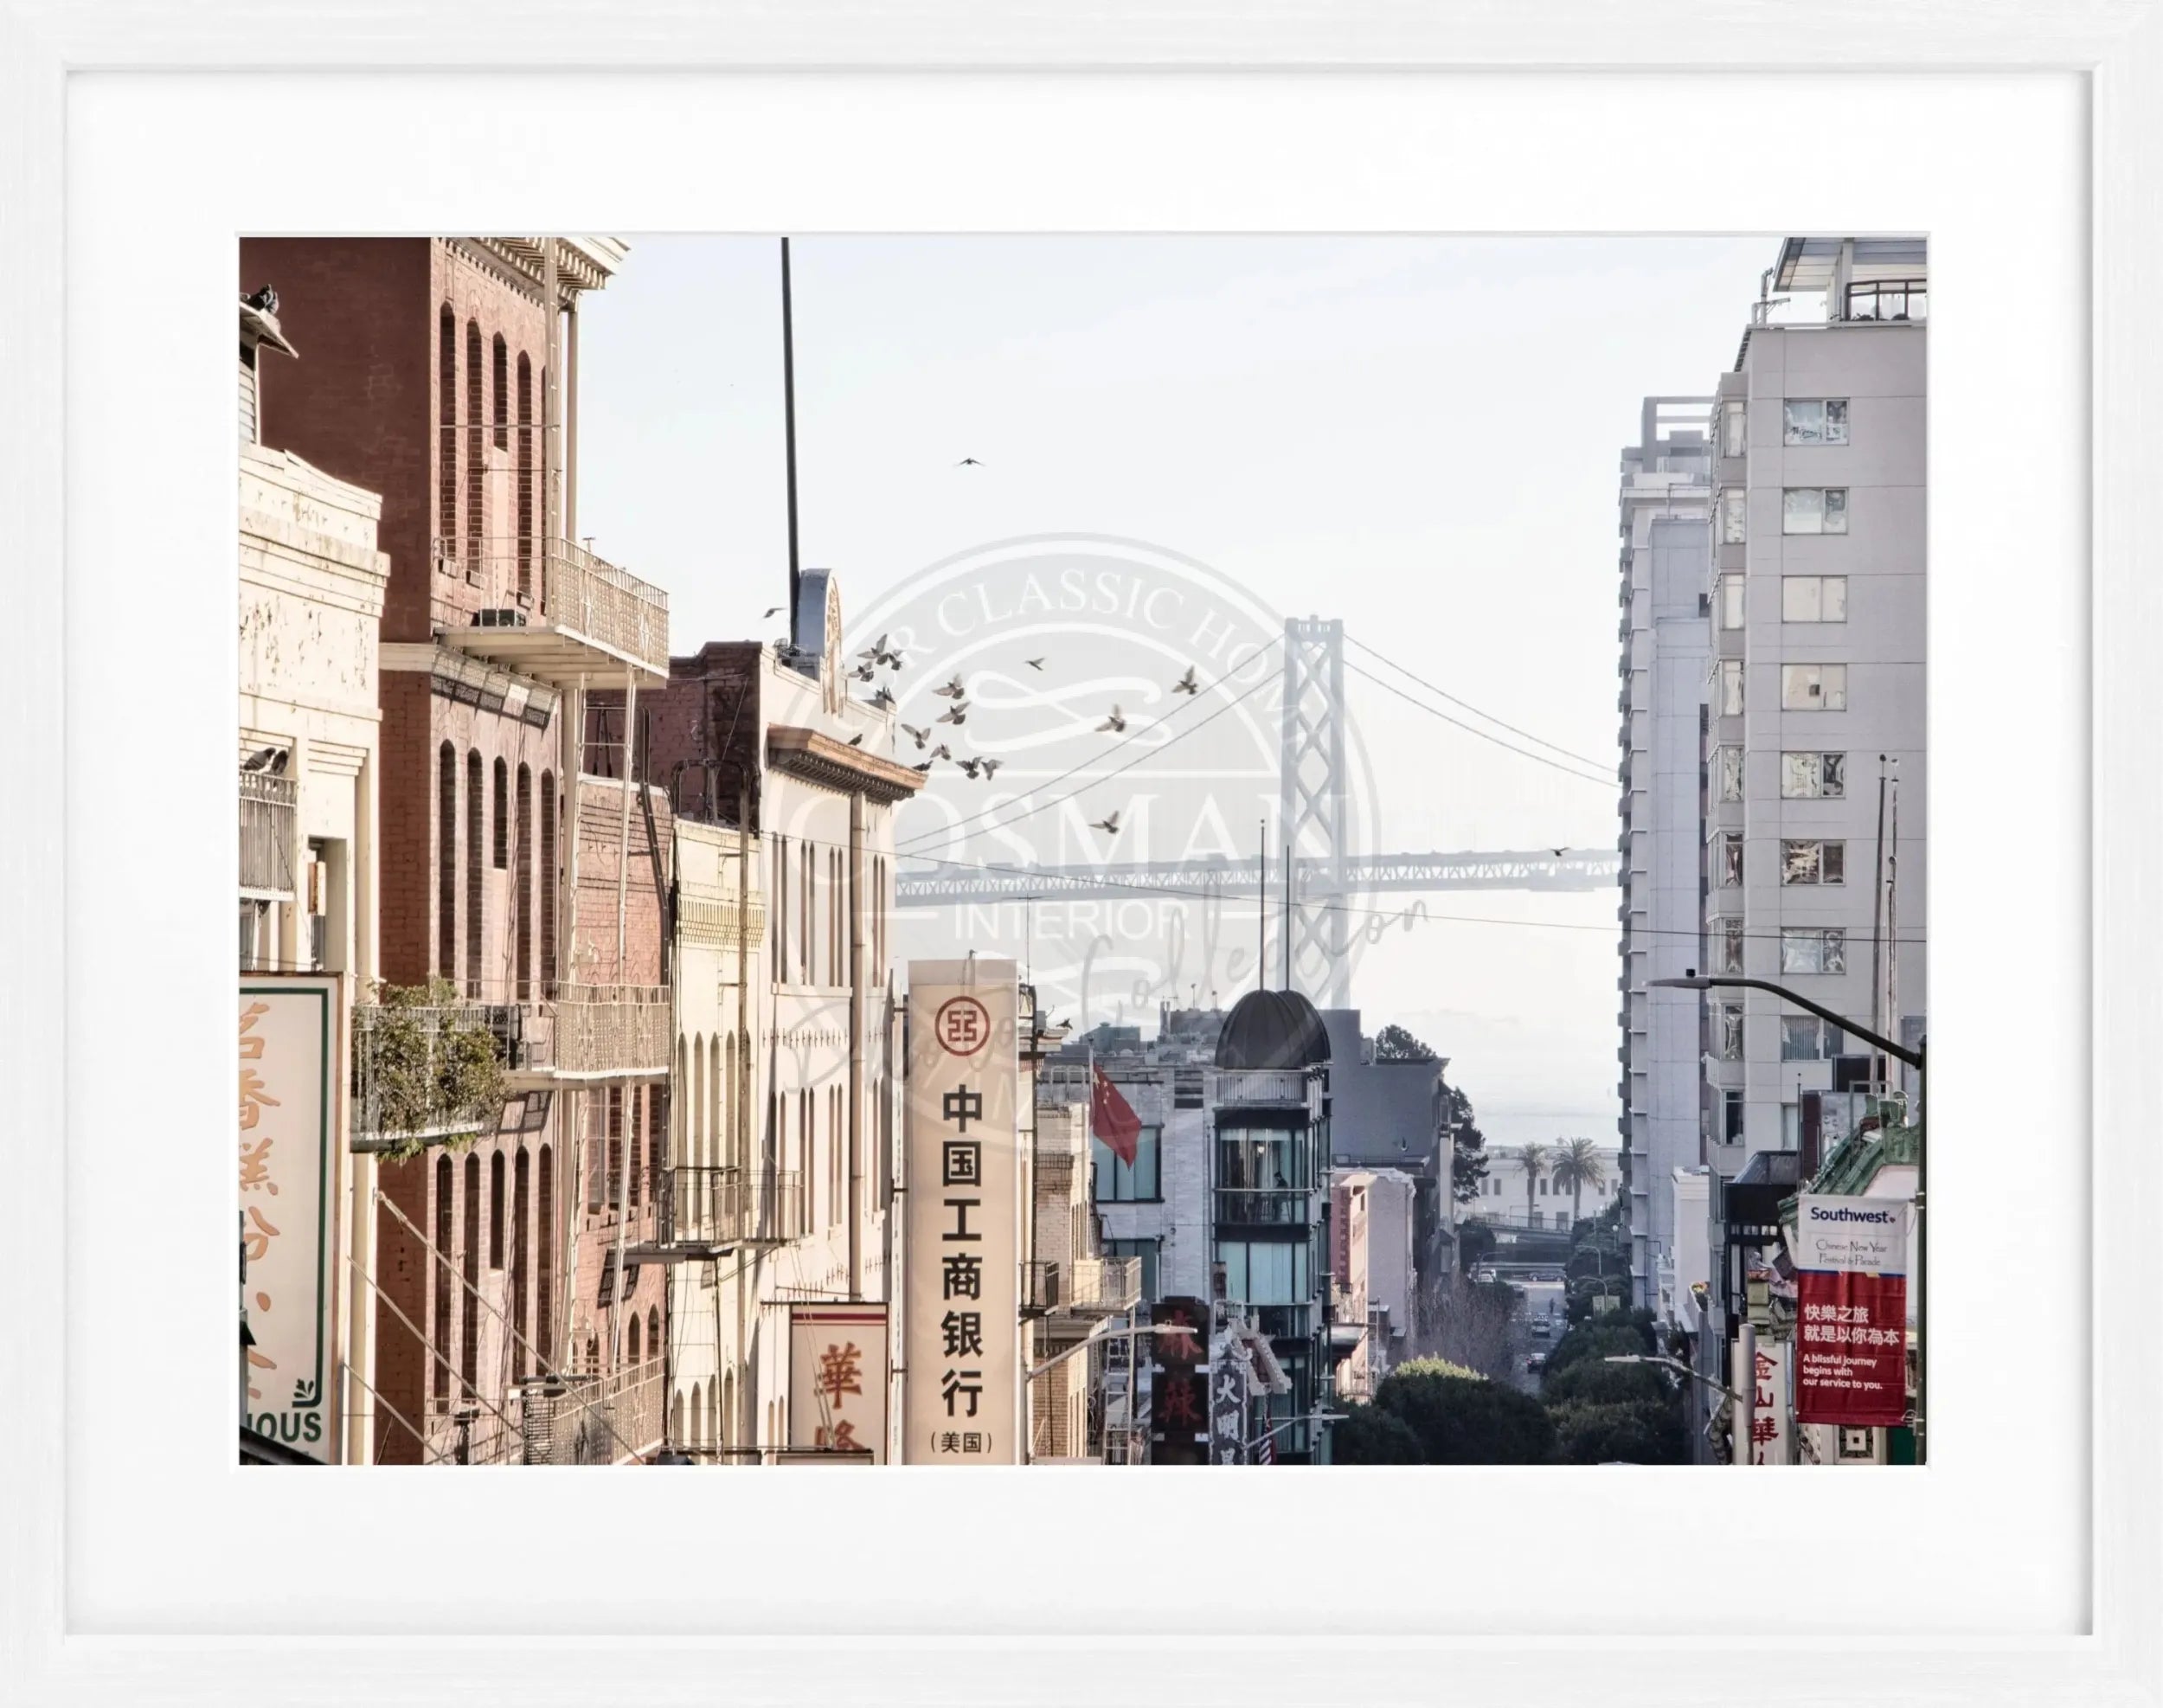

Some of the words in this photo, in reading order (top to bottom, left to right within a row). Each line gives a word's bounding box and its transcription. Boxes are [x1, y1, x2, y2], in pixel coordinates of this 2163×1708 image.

[1811, 1206, 1889, 1223] Southwest
[941, 1083, 984, 1419] 中国工商银行
[1815, 1238, 1848, 1250] Chinese
[1850, 1241, 1868, 1251] New
[1869, 1242, 1888, 1253] Year
[1819, 1253, 1845, 1264] Festival
[1855, 1255, 1881, 1266] Parade
[1804, 1303, 1869, 1324] 快樂之旅
[1803, 1325, 1900, 1346] 就是以你為本
[1803, 1354, 1810, 1363] A
[1812, 1354, 1841, 1364] blissful
[1843, 1356, 1877, 1369] journey
[1803, 1365, 1832, 1377] begins
[1833, 1367, 1853, 1377] with
[1820, 1378, 1851, 1389] service
[1864, 1382, 1883, 1391] you.
[930, 1430, 992, 1454] (美国)
